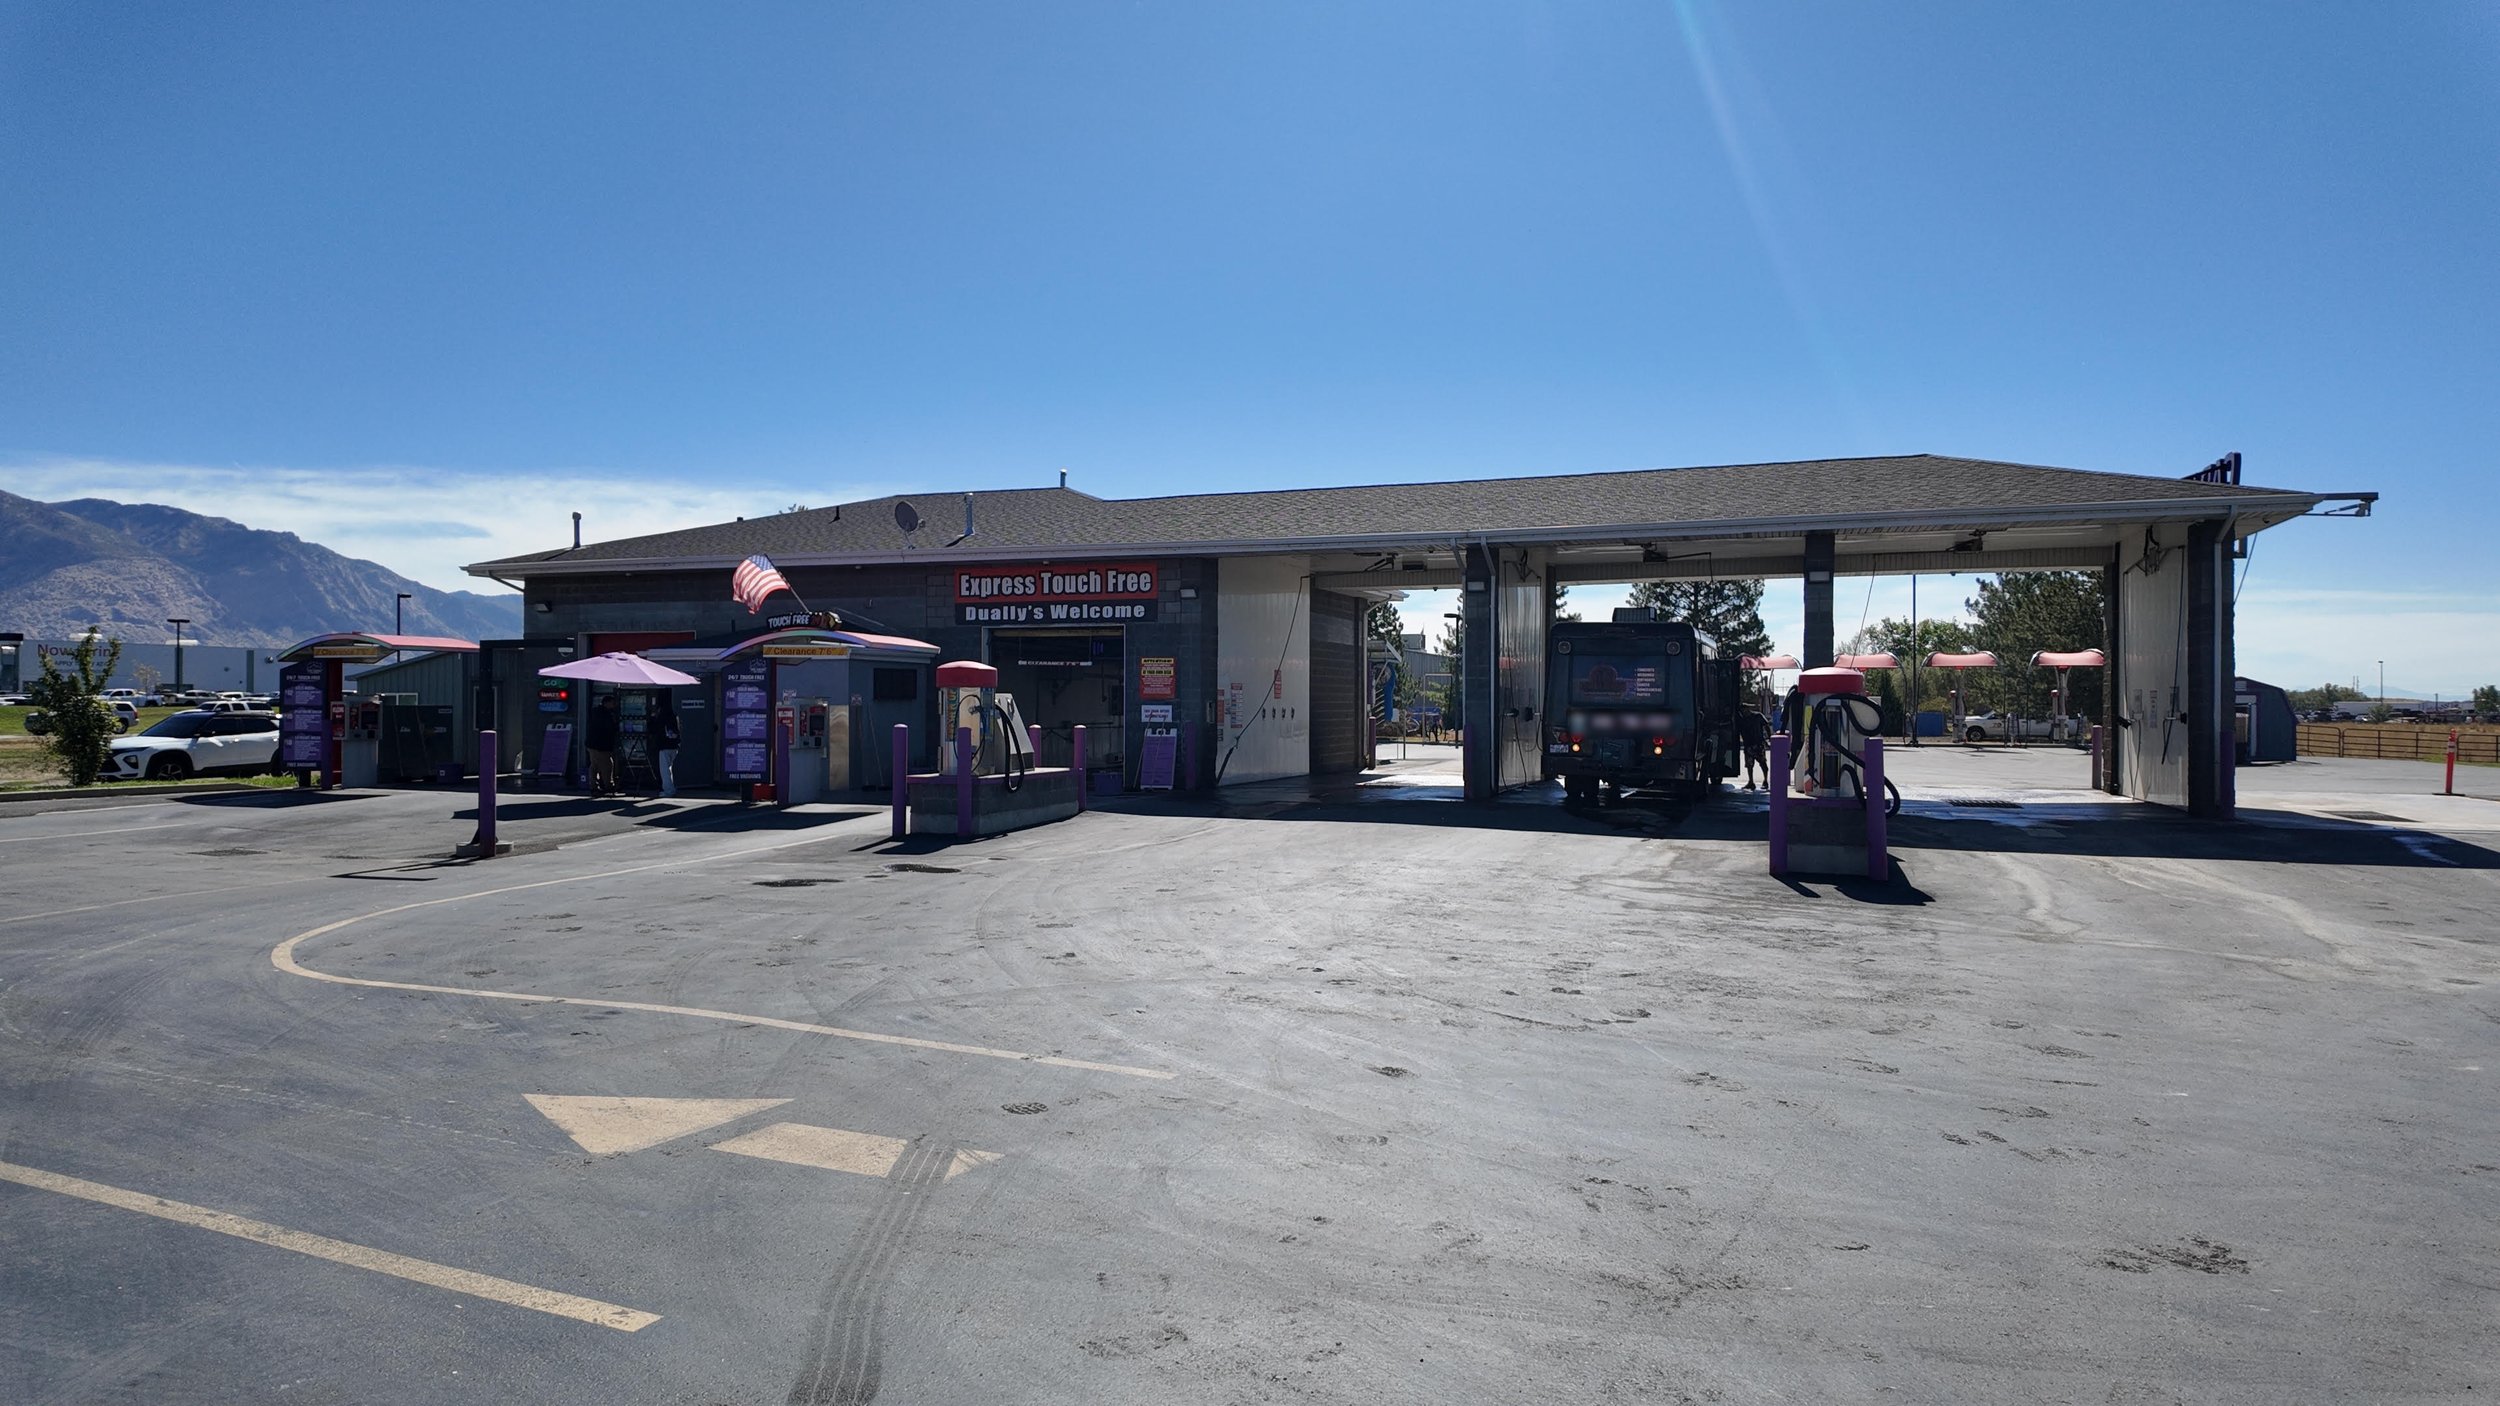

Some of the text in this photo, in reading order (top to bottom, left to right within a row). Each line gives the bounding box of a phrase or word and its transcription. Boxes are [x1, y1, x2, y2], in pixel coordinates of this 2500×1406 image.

[960, 570, 1152, 597] Express Touch Free
[965, 604, 1146, 622] Dually's Welcome
[768, 615, 791, 629] TOUCH
[792, 614, 810, 625] FREE
[773, 647, 817, 655] Clearance
